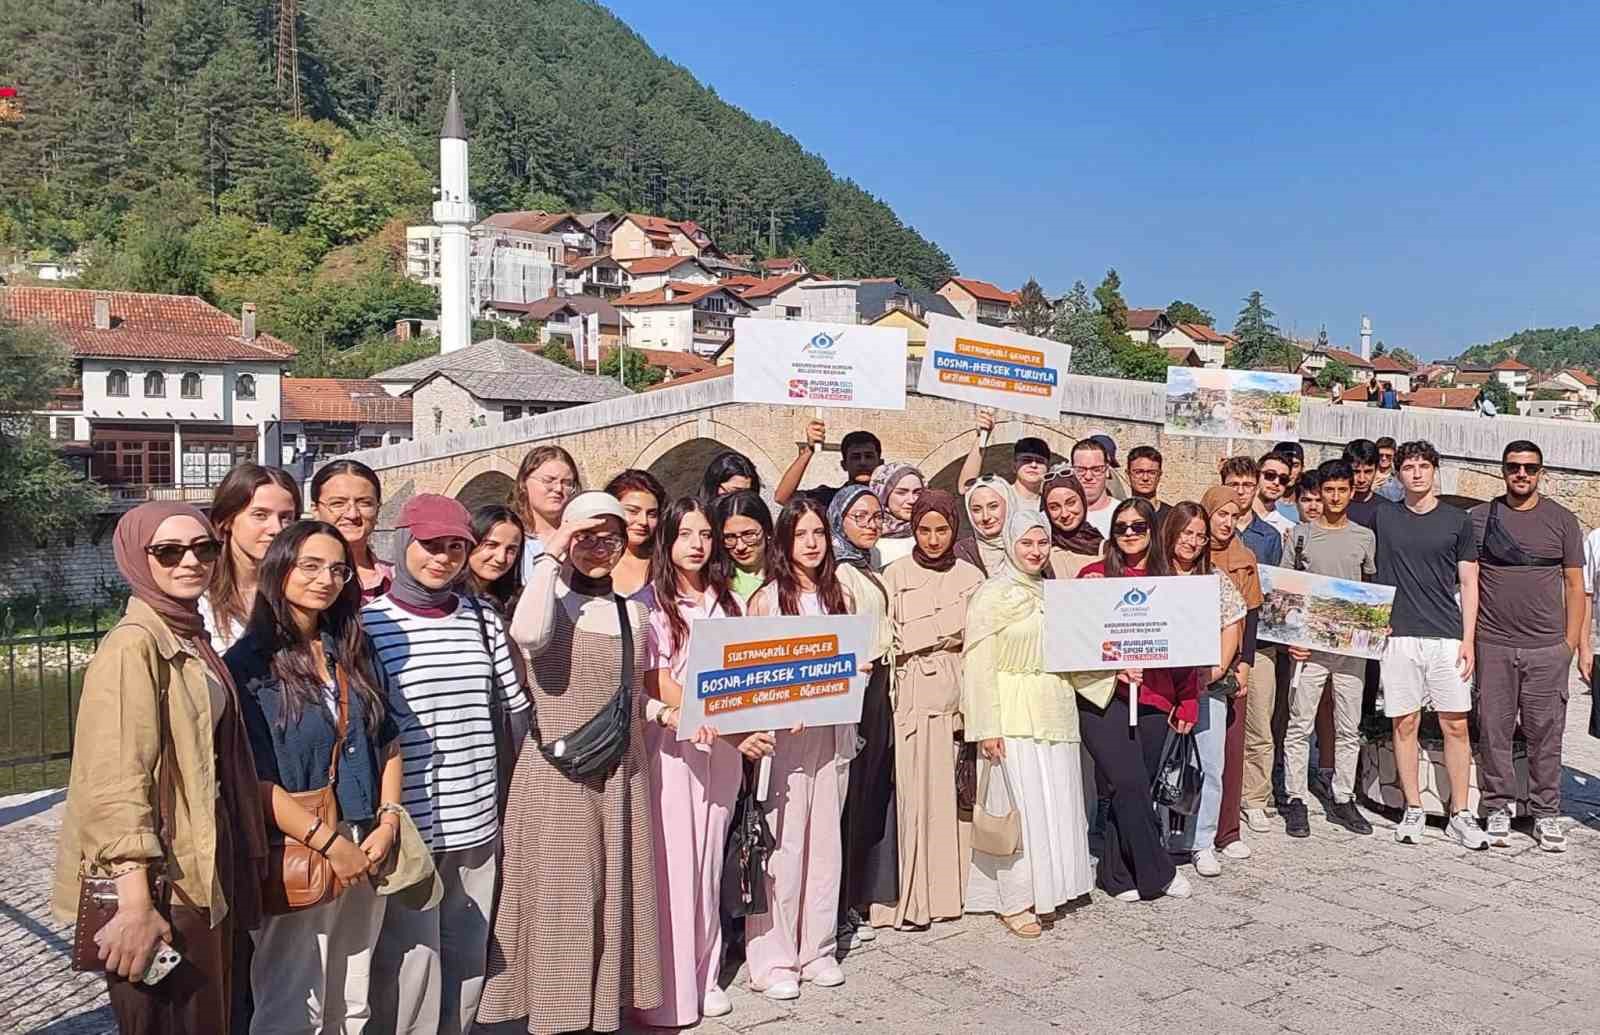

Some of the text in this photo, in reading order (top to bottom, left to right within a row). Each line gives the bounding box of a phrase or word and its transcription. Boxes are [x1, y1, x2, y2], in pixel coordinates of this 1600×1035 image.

[937, 357, 1055, 383] BOSNA-HERSEK TURUYLA
[792, 641, 833, 656] GENÇLER
[1122, 639, 1153, 647] AVRUPA
[701, 660, 852, 694] BOSNA-HERSEK TURUYLA
[708, 695, 743, 712] GEZİYOR
